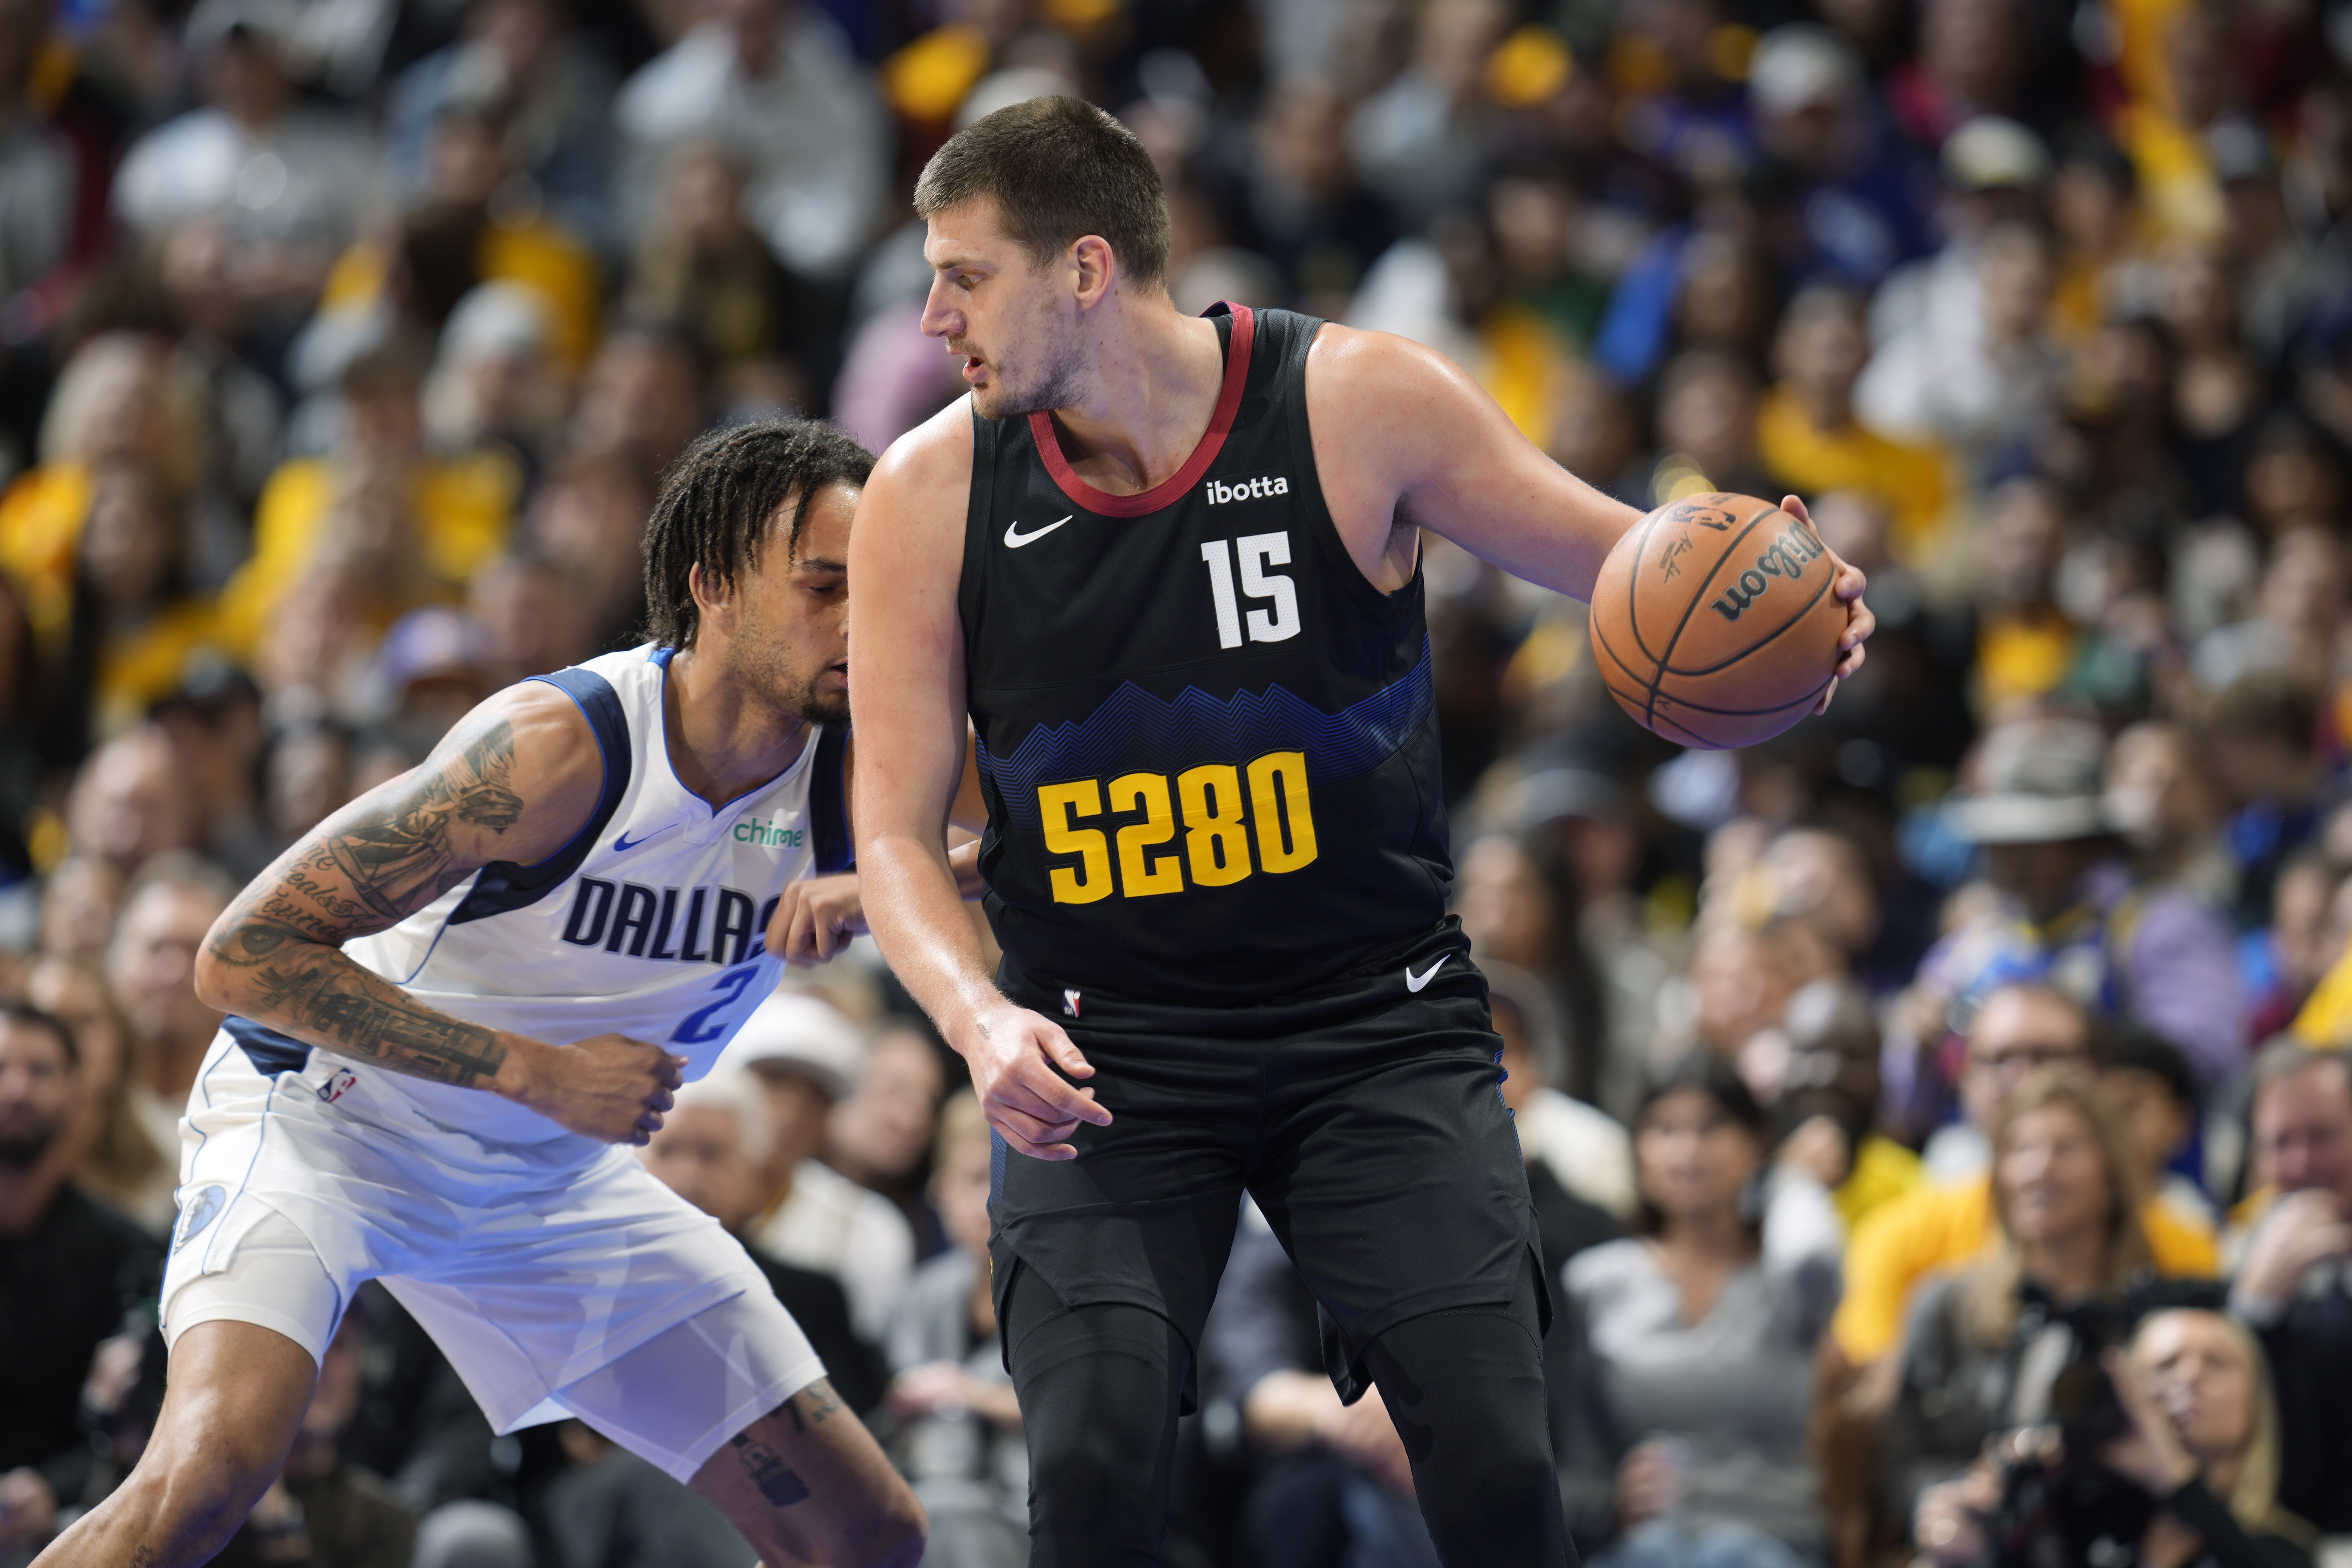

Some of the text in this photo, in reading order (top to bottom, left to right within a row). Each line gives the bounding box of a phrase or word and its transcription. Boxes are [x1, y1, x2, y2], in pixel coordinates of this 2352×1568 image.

[1206, 476, 1289, 505] ibotta
[1200, 531, 1301, 649] 15
[1710, 519, 1824, 622] Wilson
[733, 818, 803, 848] chime
[1035, 749, 1319, 905] 5280
[668, 964, 761, 1044] 2
[1064, 1005, 1073, 1015] NBA
